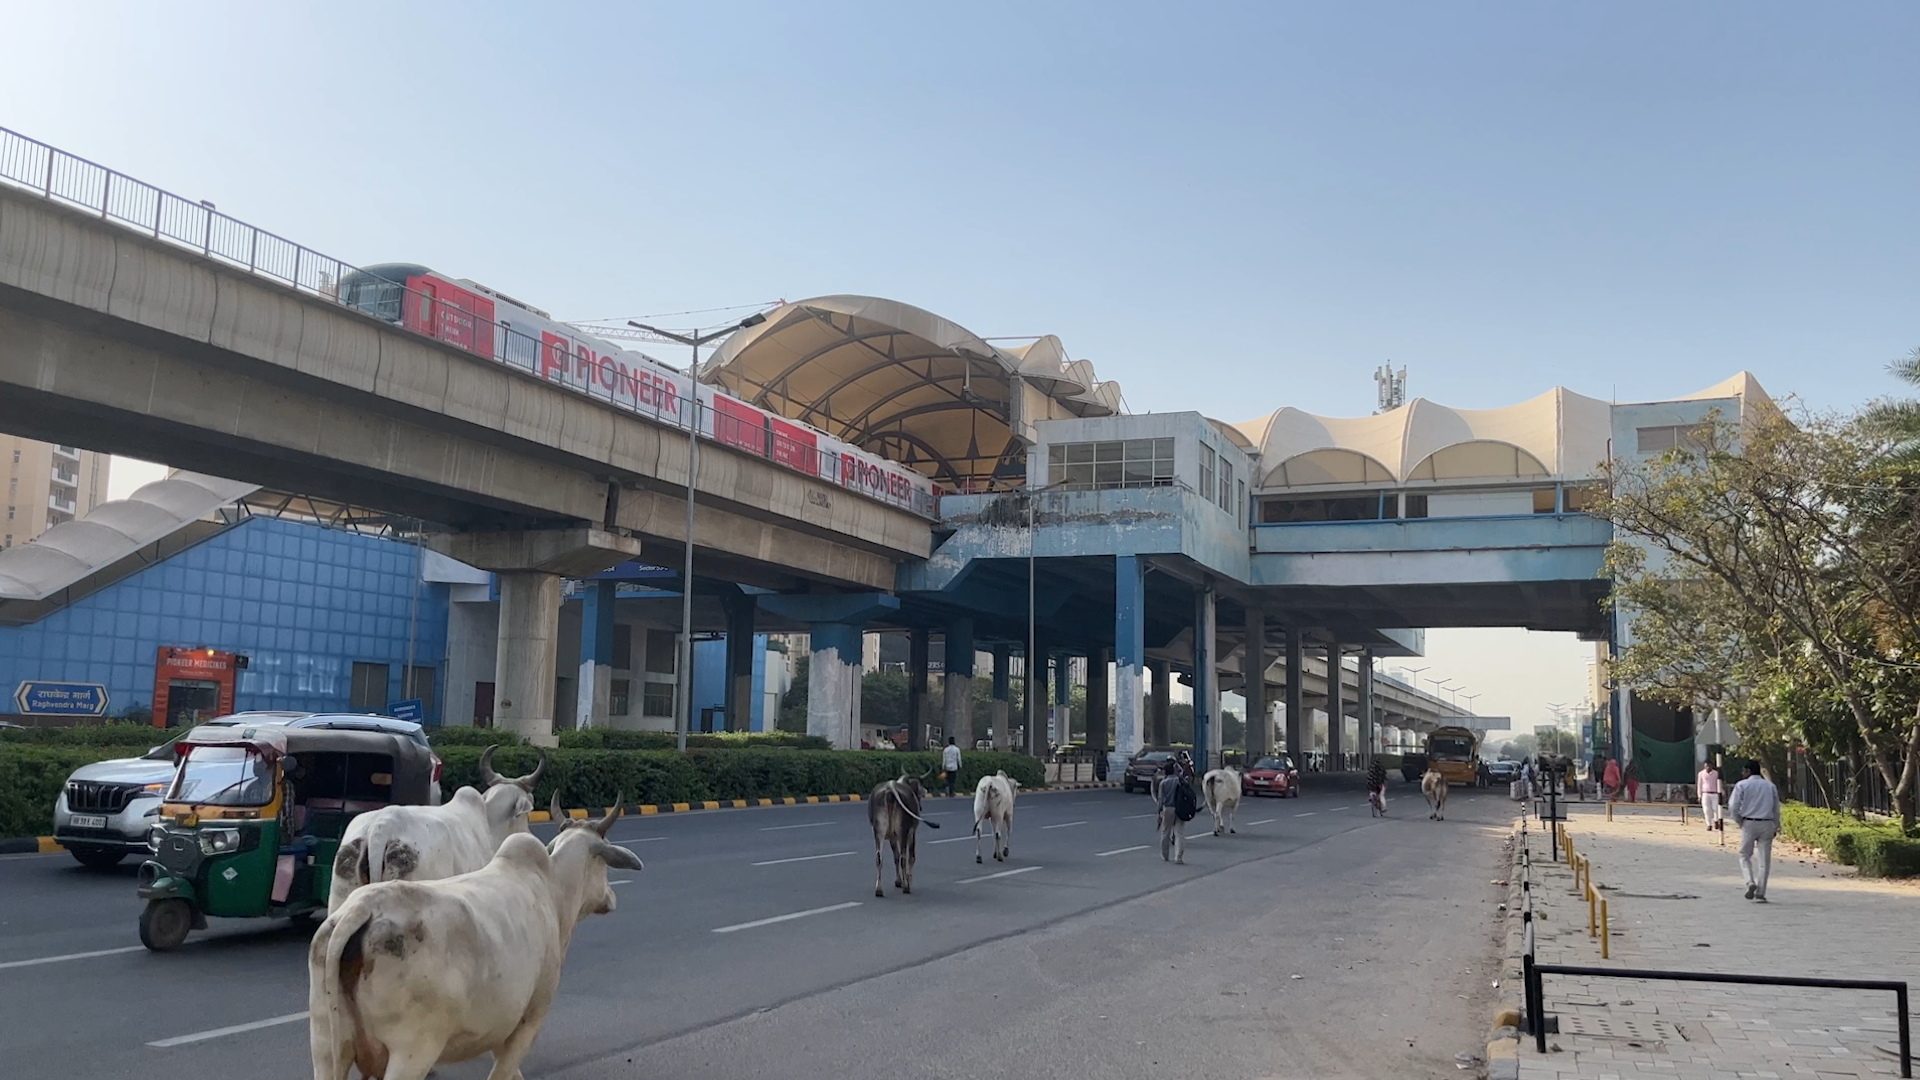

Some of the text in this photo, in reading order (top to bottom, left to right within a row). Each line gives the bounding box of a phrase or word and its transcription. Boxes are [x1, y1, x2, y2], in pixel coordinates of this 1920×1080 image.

[577, 344, 677, 414] PIONEER
[858, 459, 911, 502] PIONEER
[166, 658, 227, 670] PIONEER MEDICINES
[72, 690, 91, 700] मार्ग
[32, 699, 94, 711] Raghvendra Marg
